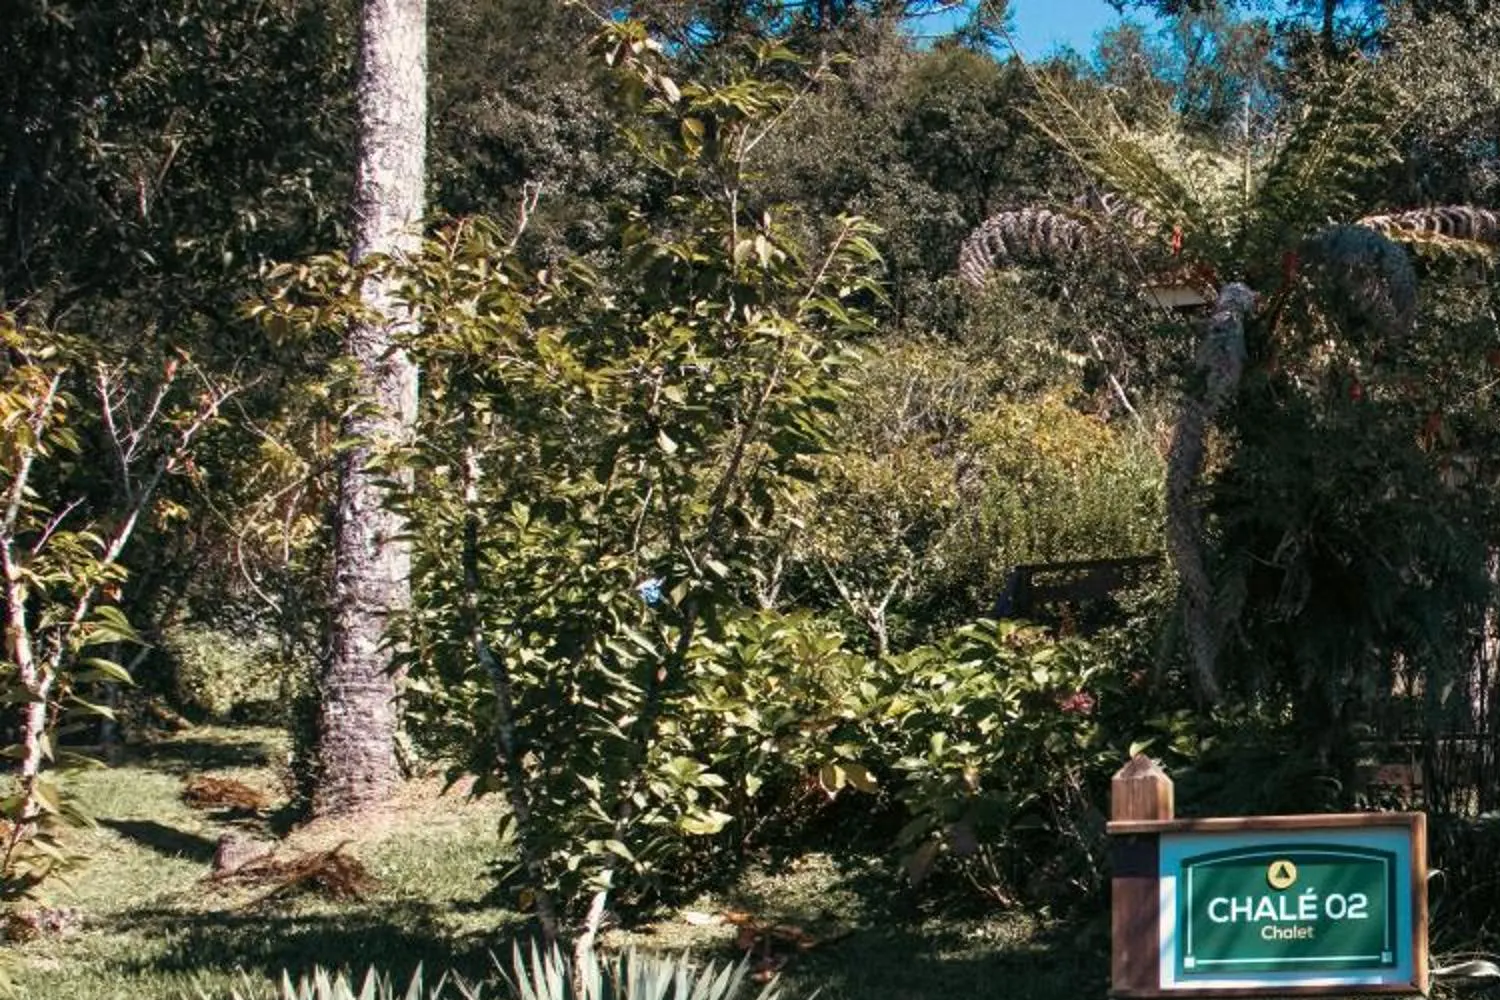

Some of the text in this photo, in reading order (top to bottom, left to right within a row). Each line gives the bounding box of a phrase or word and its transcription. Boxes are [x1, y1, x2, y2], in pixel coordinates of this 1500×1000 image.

[1207, 887, 1368, 923] CHALÉ 02
[1260, 925, 1315, 940] Chalet
